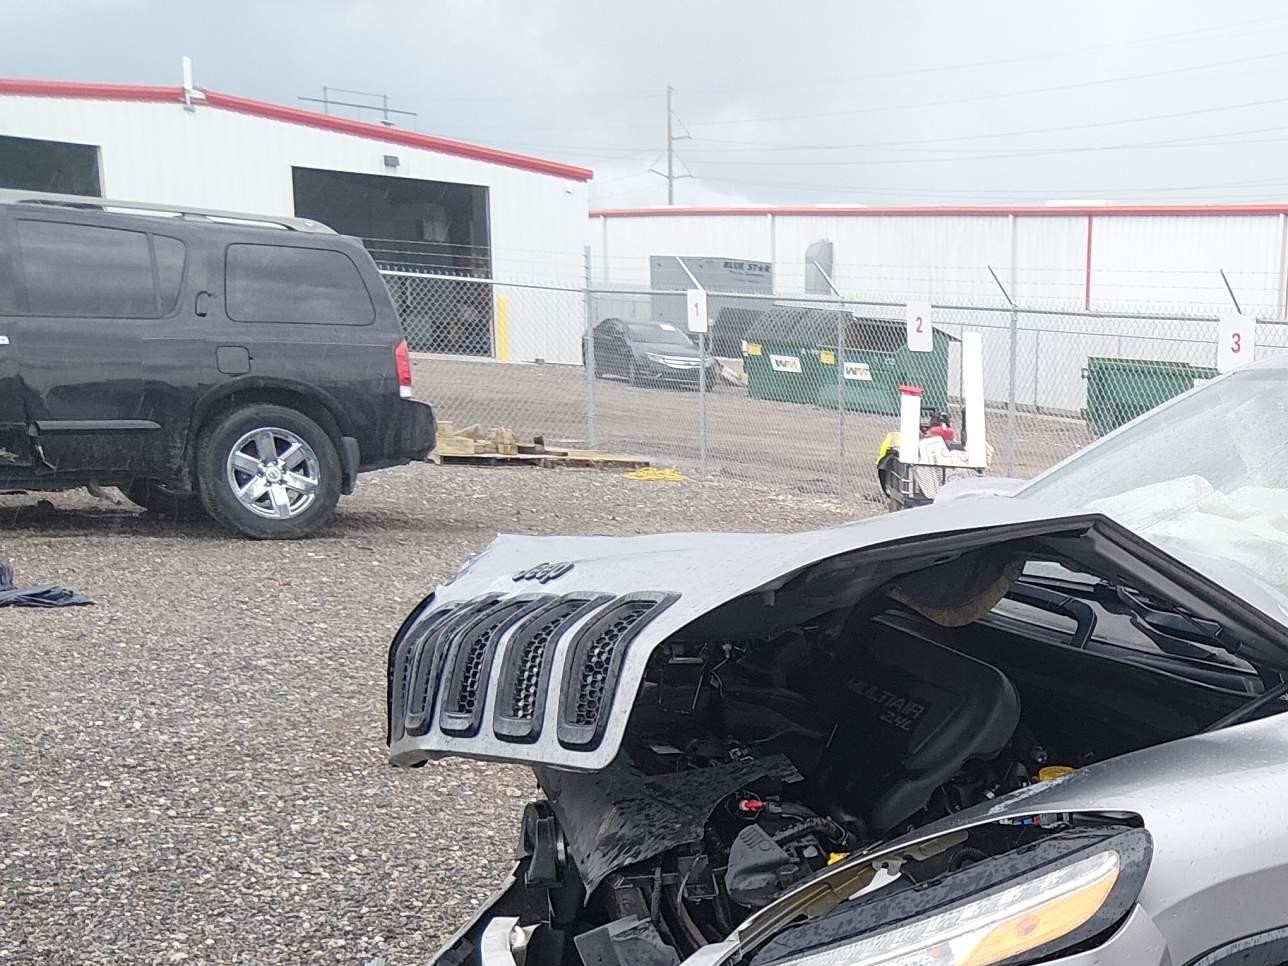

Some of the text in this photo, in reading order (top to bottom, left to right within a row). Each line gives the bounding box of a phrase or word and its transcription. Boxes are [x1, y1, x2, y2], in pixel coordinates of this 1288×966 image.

[694, 302, 700, 317] 1
[915, 315, 923, 334] 2
[1230, 331, 1241, 354] 3
[512, 562, 575, 585] Jeep
